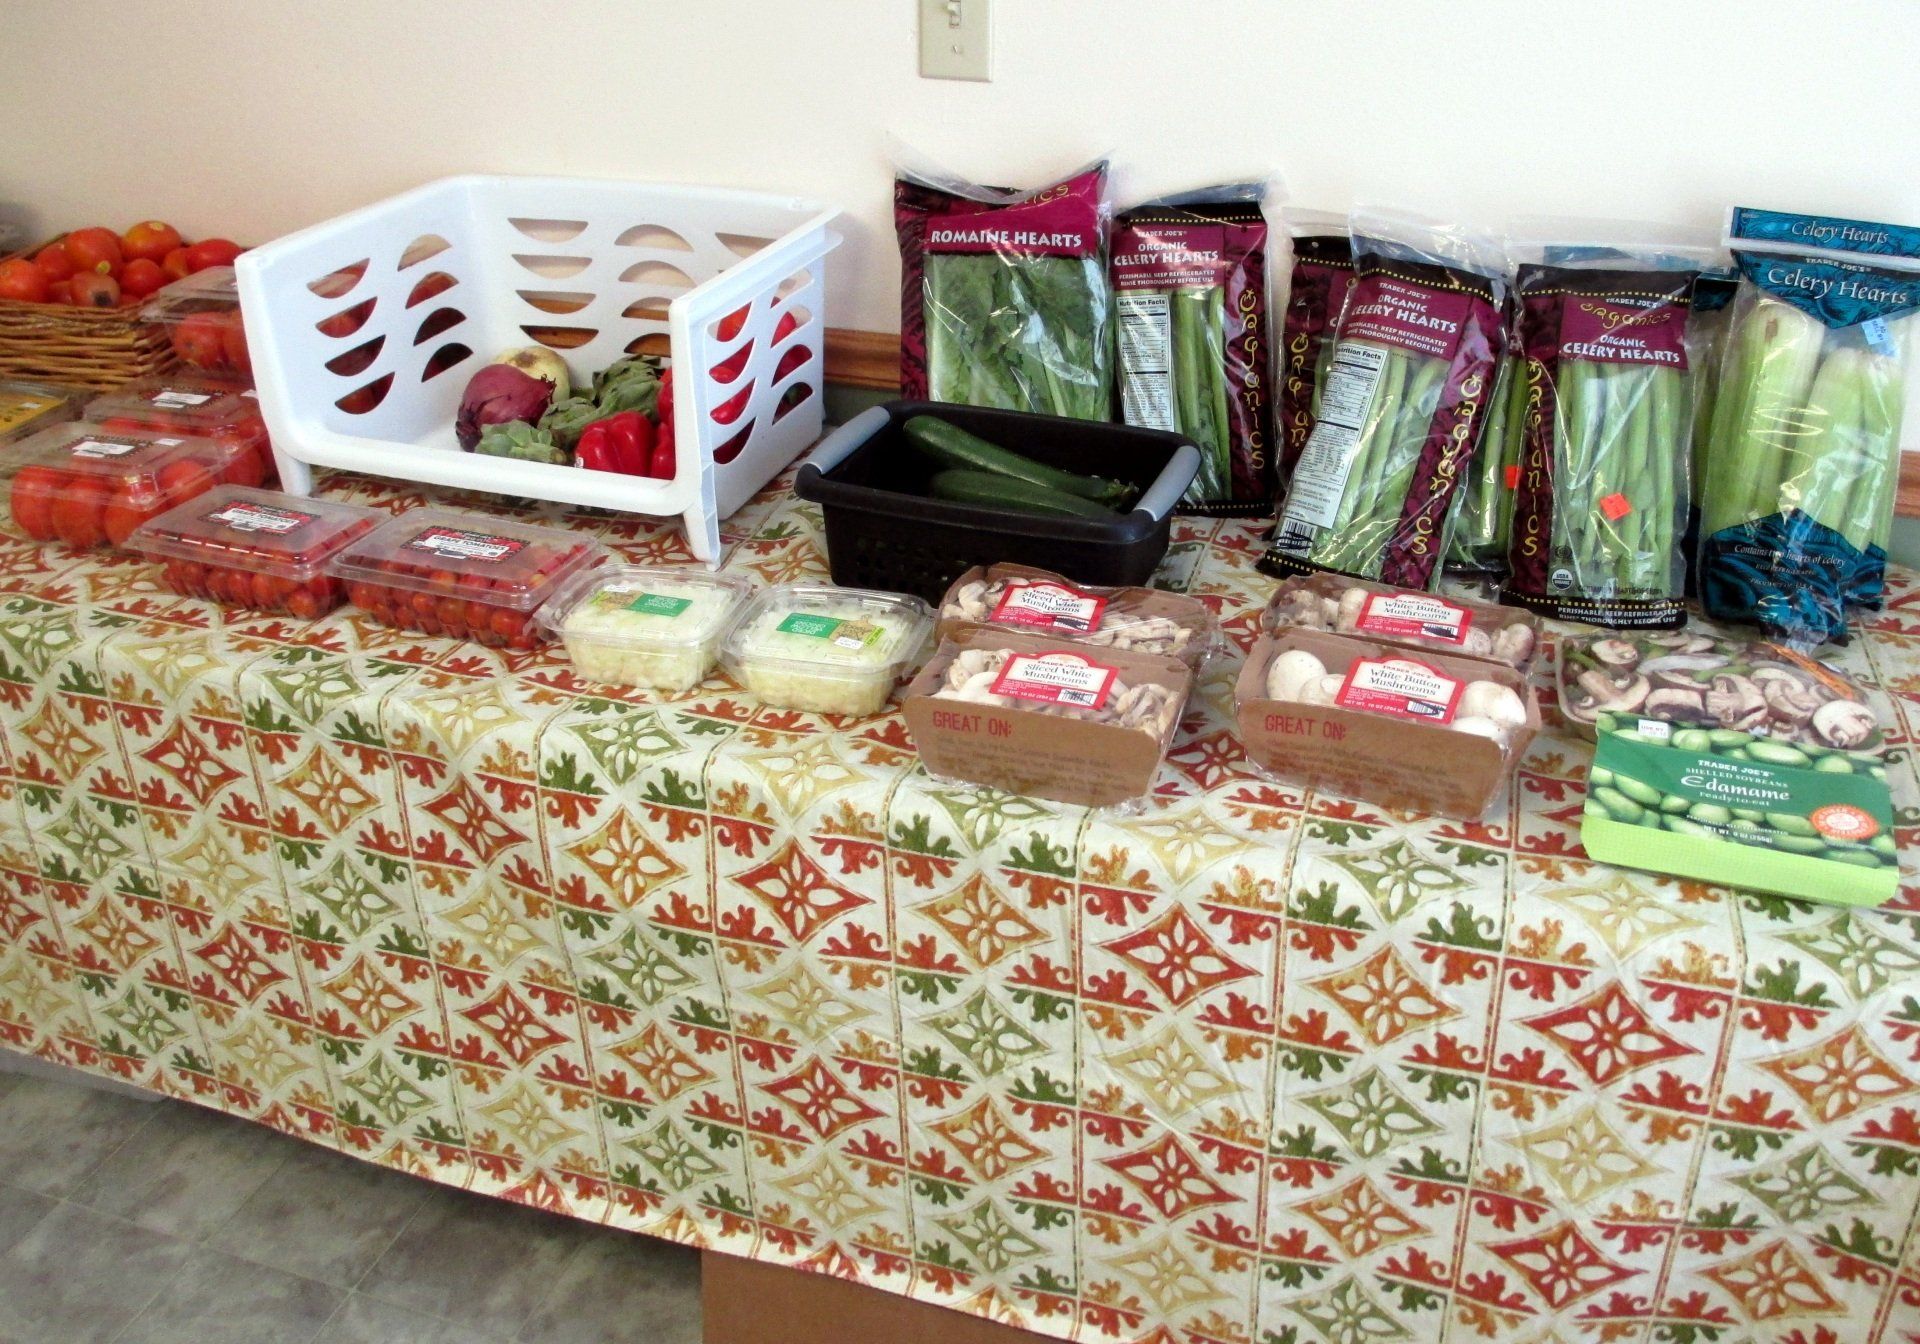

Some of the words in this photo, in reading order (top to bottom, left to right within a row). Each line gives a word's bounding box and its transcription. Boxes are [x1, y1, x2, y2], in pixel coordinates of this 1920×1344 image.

[931, 230, 1009, 245] ROMAINE
[1014, 231, 1082, 248] HEARTS
[1791, 220, 1838, 243] Celery
[1841, 226, 1889, 244] Hearts
[1138, 242, 1187, 252] ORGANIC
[1114, 253, 1158, 266] CELERY
[1162, 250, 1219, 264] HEARTS
[1380, 282, 1405, 293] TRADER
[1767, 268, 1833, 300] Celery
[1838, 280, 1908, 304] Hearts
[1378, 294, 1428, 313] ORGANIC
[1396, 309, 1458, 334] HEARTS
[1398, 329, 1448, 347] REFRIGERATED
[1404, 338, 1431, 351] BEFORE
[1600, 335, 1647, 348] ORGANIC
[1362, 351, 1381, 360] Facts
[1563, 342, 1615, 358] CELERY
[1620, 349, 1680, 363] HEARTS
[1021, 597, 1080, 613] Mushrooms
[1022, 591, 1052, 603] Sliced
[1054, 598, 1083, 608] White
[1384, 601, 1414, 610] White
[1416, 604, 1451, 616] Button
[1384, 607, 1448, 620] Mushrooms
[1023, 670, 1088, 686] Mushrooms
[1025, 663, 1058, 673] Sliced
[1061, 668, 1091, 679] White
[1370, 668, 1402, 679] White
[1404, 674, 1441, 690] Button
[1369, 677, 1437, 696] Mushrooms
[932, 711, 981, 733] GREAT
[988, 718, 1012, 738] ON:
[1264, 715, 1315, 737] GREAT
[1322, 721, 1347, 741] ON:
[1698, 760, 1738, 772] TRADER
[1685, 767, 1733, 779] SHELLED
[1735, 773, 1789, 788] SOYBEANS
[1680, 775, 1791, 800] Edamame
